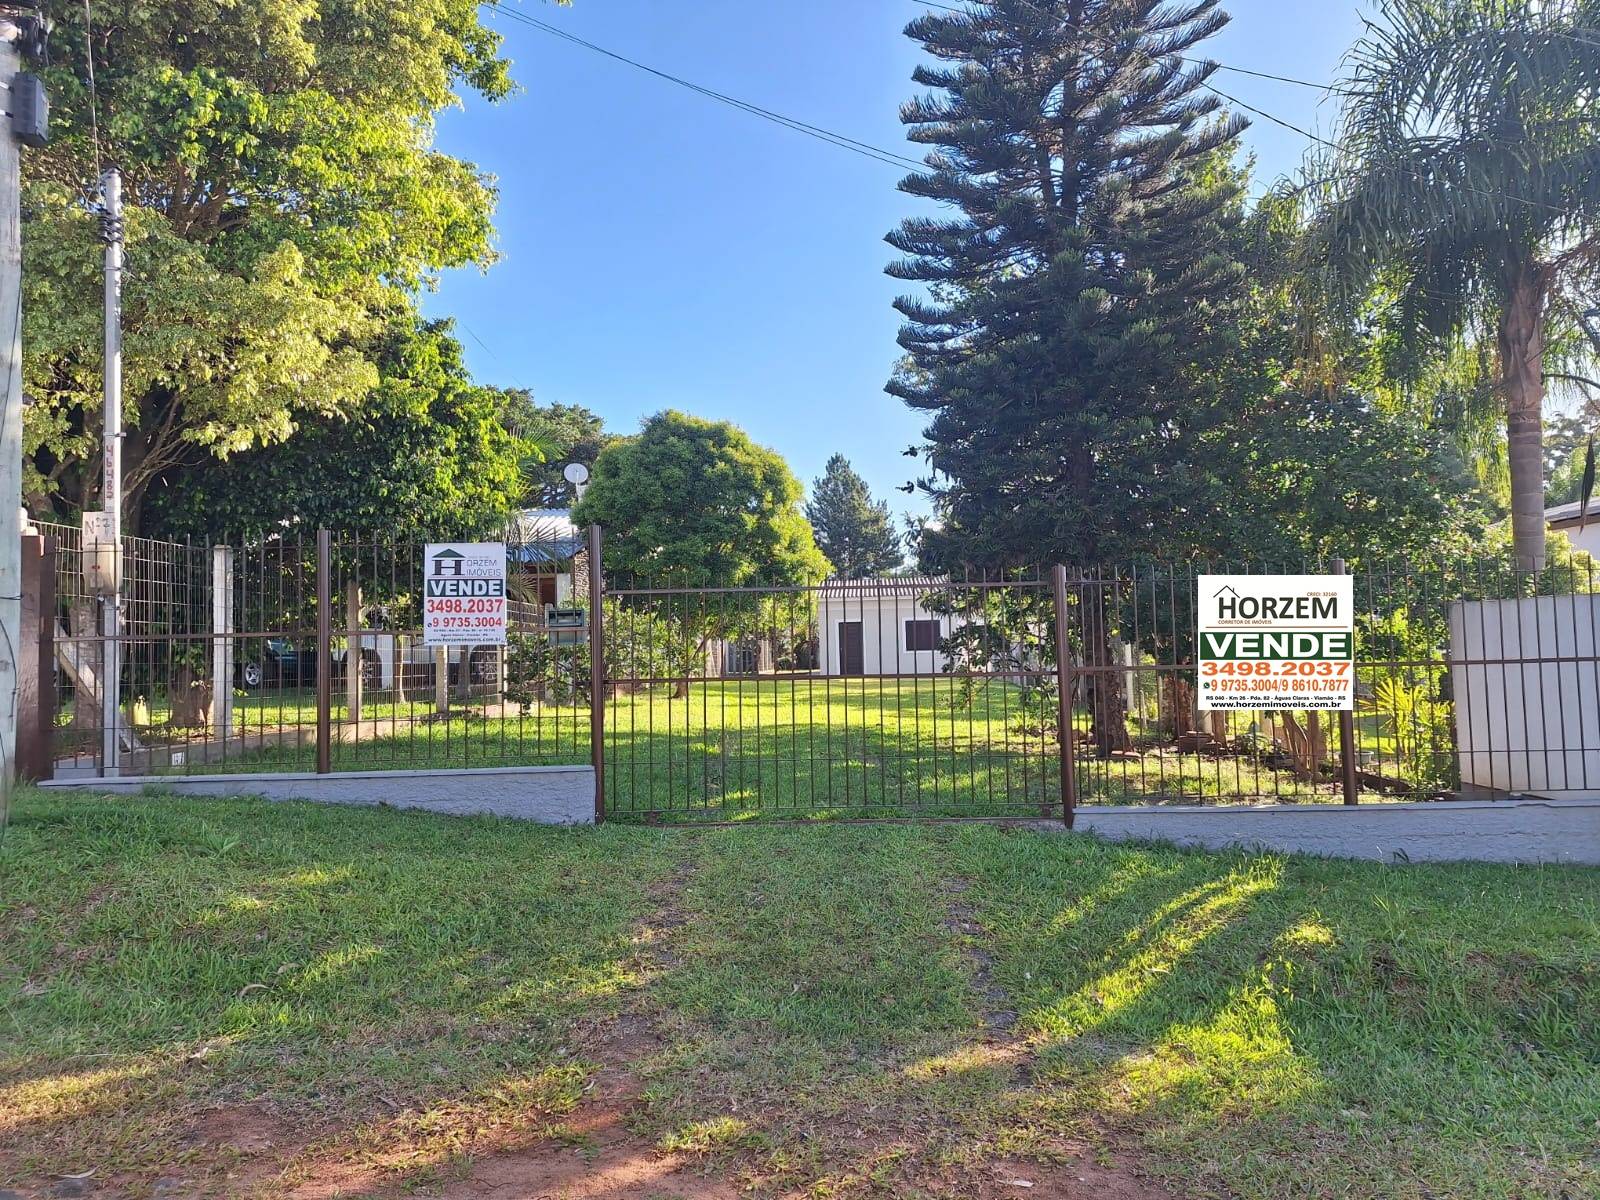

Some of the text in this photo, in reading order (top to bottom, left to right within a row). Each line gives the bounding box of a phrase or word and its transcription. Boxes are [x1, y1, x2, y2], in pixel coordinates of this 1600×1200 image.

[430, 580, 500, 596] VENDE
[427, 599, 503, 614] 3498.2037
[1218, 597, 1338, 619] HORZEM
[432, 617, 502, 628] 9 9735.3004
[1205, 633, 1347, 658] VENDE
[1201, 662, 1351, 676] 3498.2037
[1211, 679, 1218, 692] 9
[1292, 679, 1349, 692] 8610.7877
